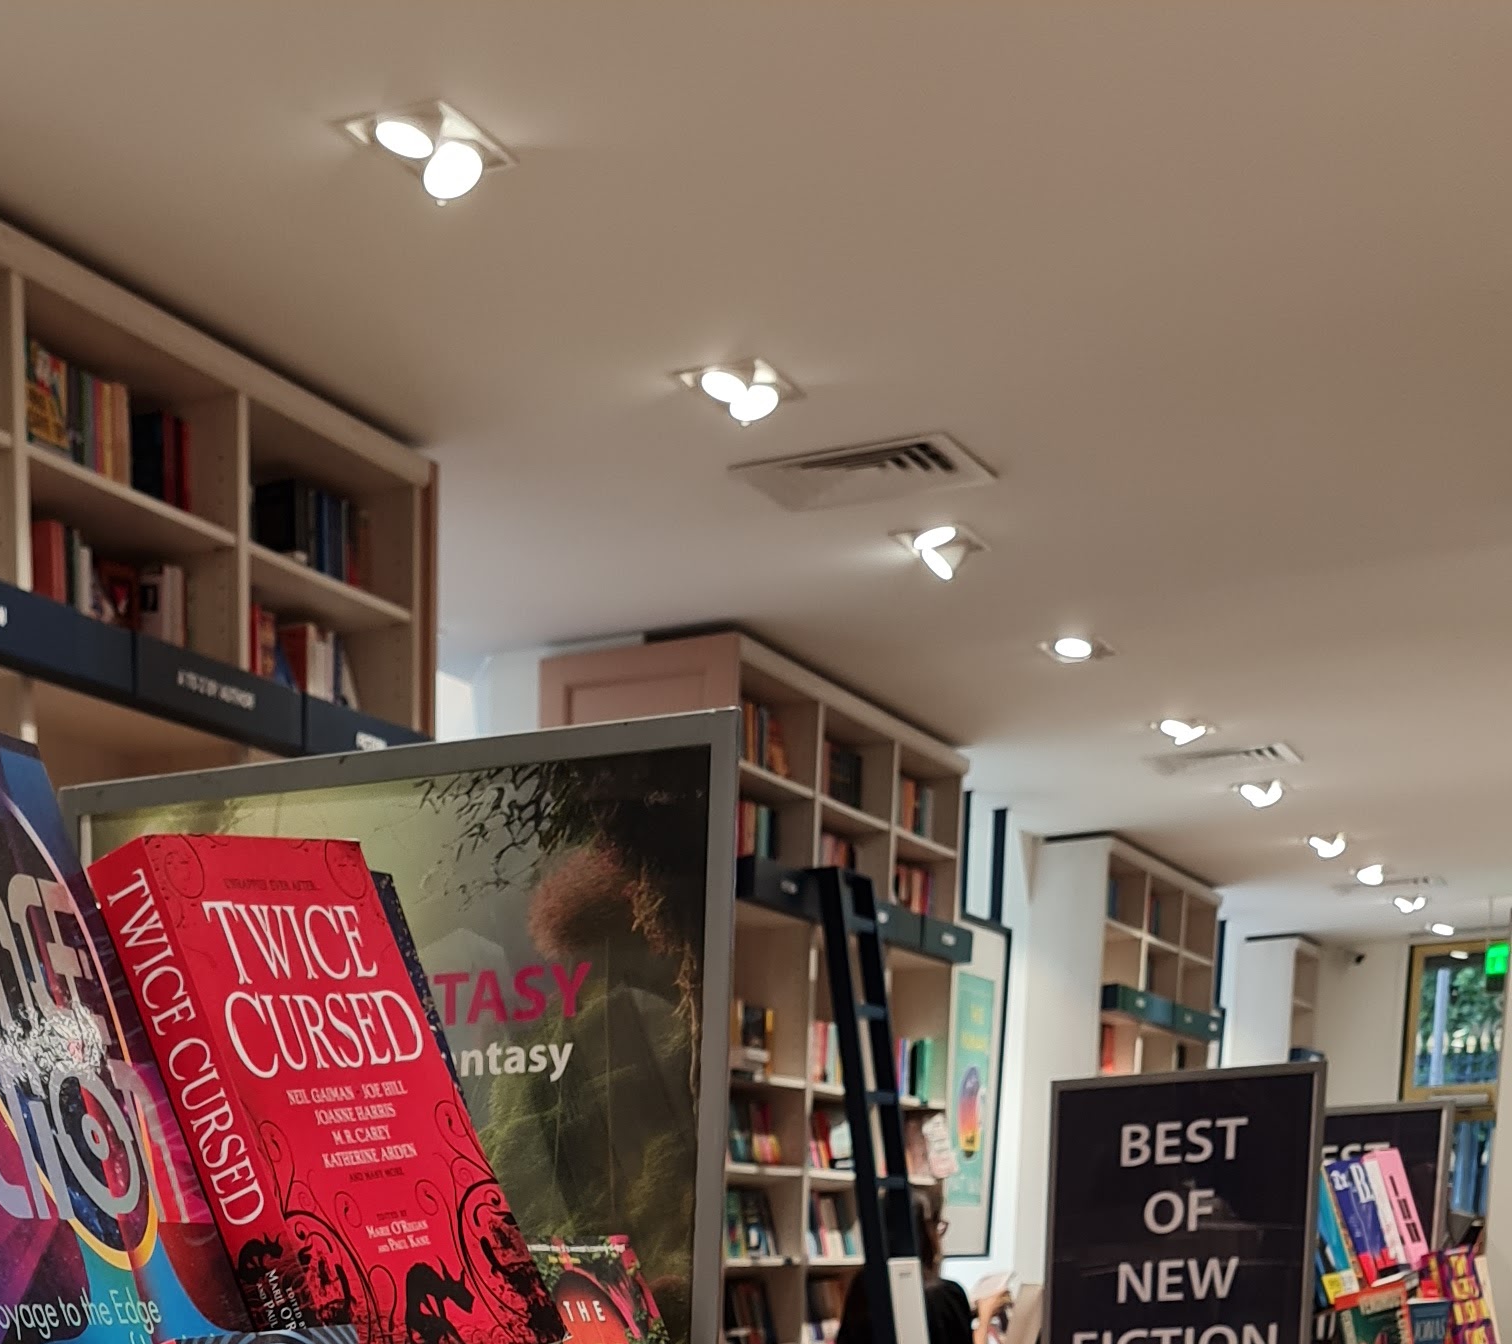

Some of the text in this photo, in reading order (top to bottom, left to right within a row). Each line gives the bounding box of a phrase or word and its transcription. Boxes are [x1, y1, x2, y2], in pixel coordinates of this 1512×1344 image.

[107, 869, 196, 1036] TWICE
[203, 900, 377, 984] TWICE
[225, 990, 424, 1079] CURSED
[168, 1038, 265, 1225] CURSED
[1119, 1117, 1249, 1168] BEST
[1144, 1187, 1215, 1236] OF
[1117, 1255, 1240, 1305] NEW
[61, 1295, 81, 1327] to
[84, 1290, 110, 1327] the
[113, 1288, 161, 1334] Edge
[563, 1299, 606, 1324] THE
